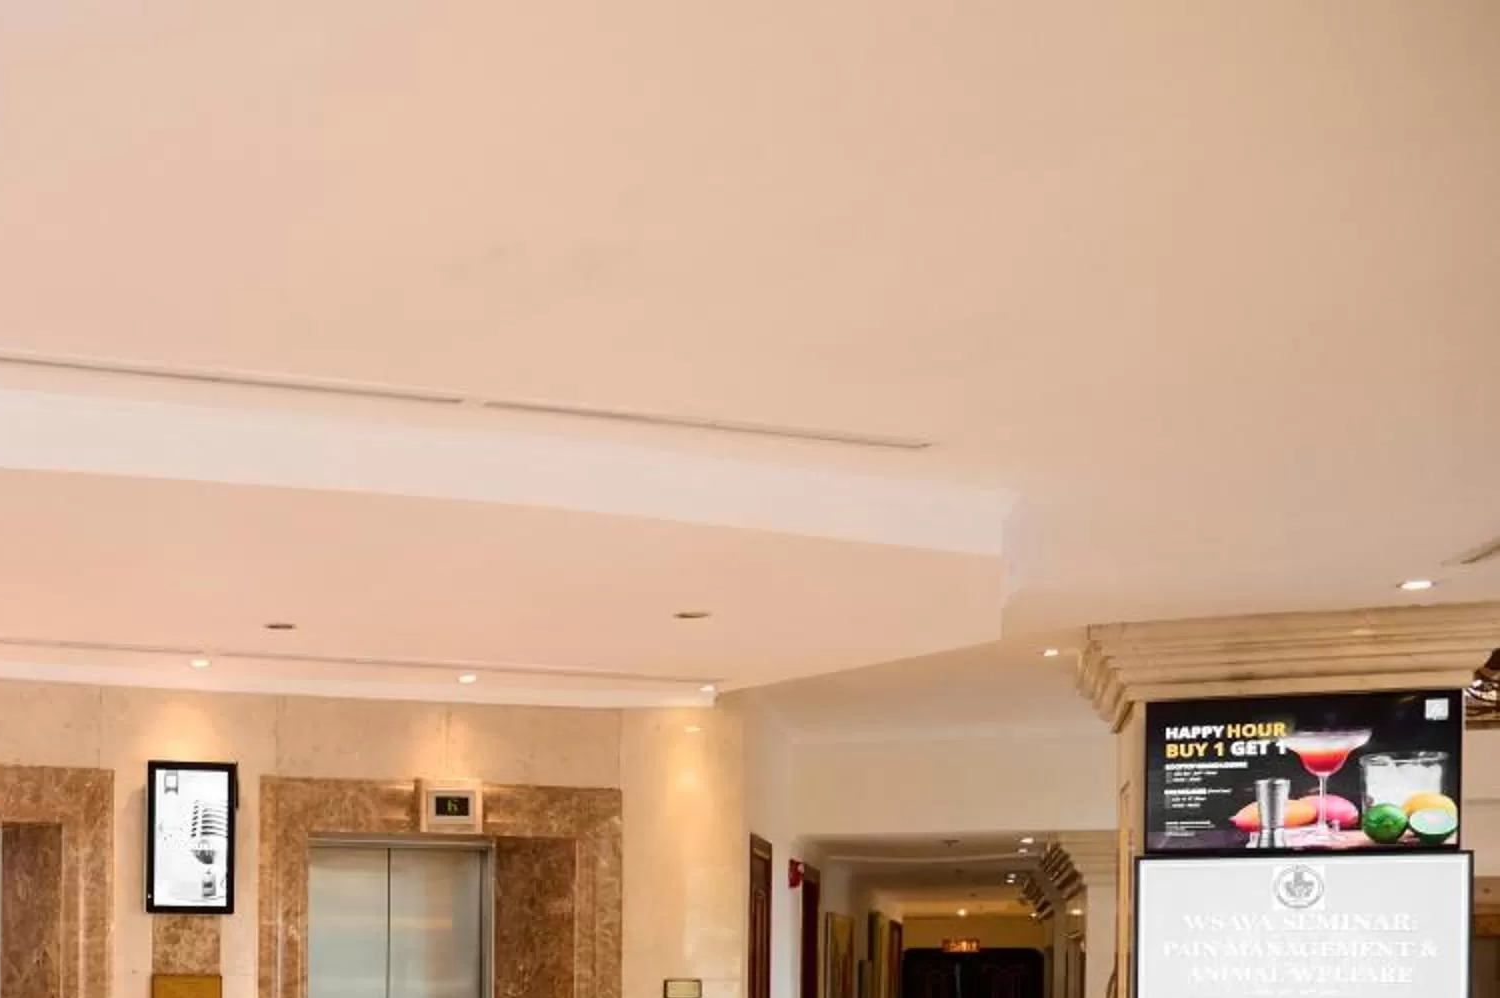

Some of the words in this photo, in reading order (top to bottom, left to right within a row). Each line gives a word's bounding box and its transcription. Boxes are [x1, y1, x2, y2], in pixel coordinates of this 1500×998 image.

[1165, 725, 1225, 740] HAPPY
[1227, 722, 1286, 738] HOUR
[1166, 742, 1208, 758] BUY
[1214, 741, 1225, 757] 1
[1230, 740, 1271, 756] GET
[1275, 740, 1287, 755] 1
[1162, 939, 1218, 957] PAIN
[1224, 940, 1417, 957] MANAGEMENT
[1420, 939, 1439, 957] &
[1189, 966, 1277, 983] ANIMAL
[1290, 966, 1413, 983] WELFARE
